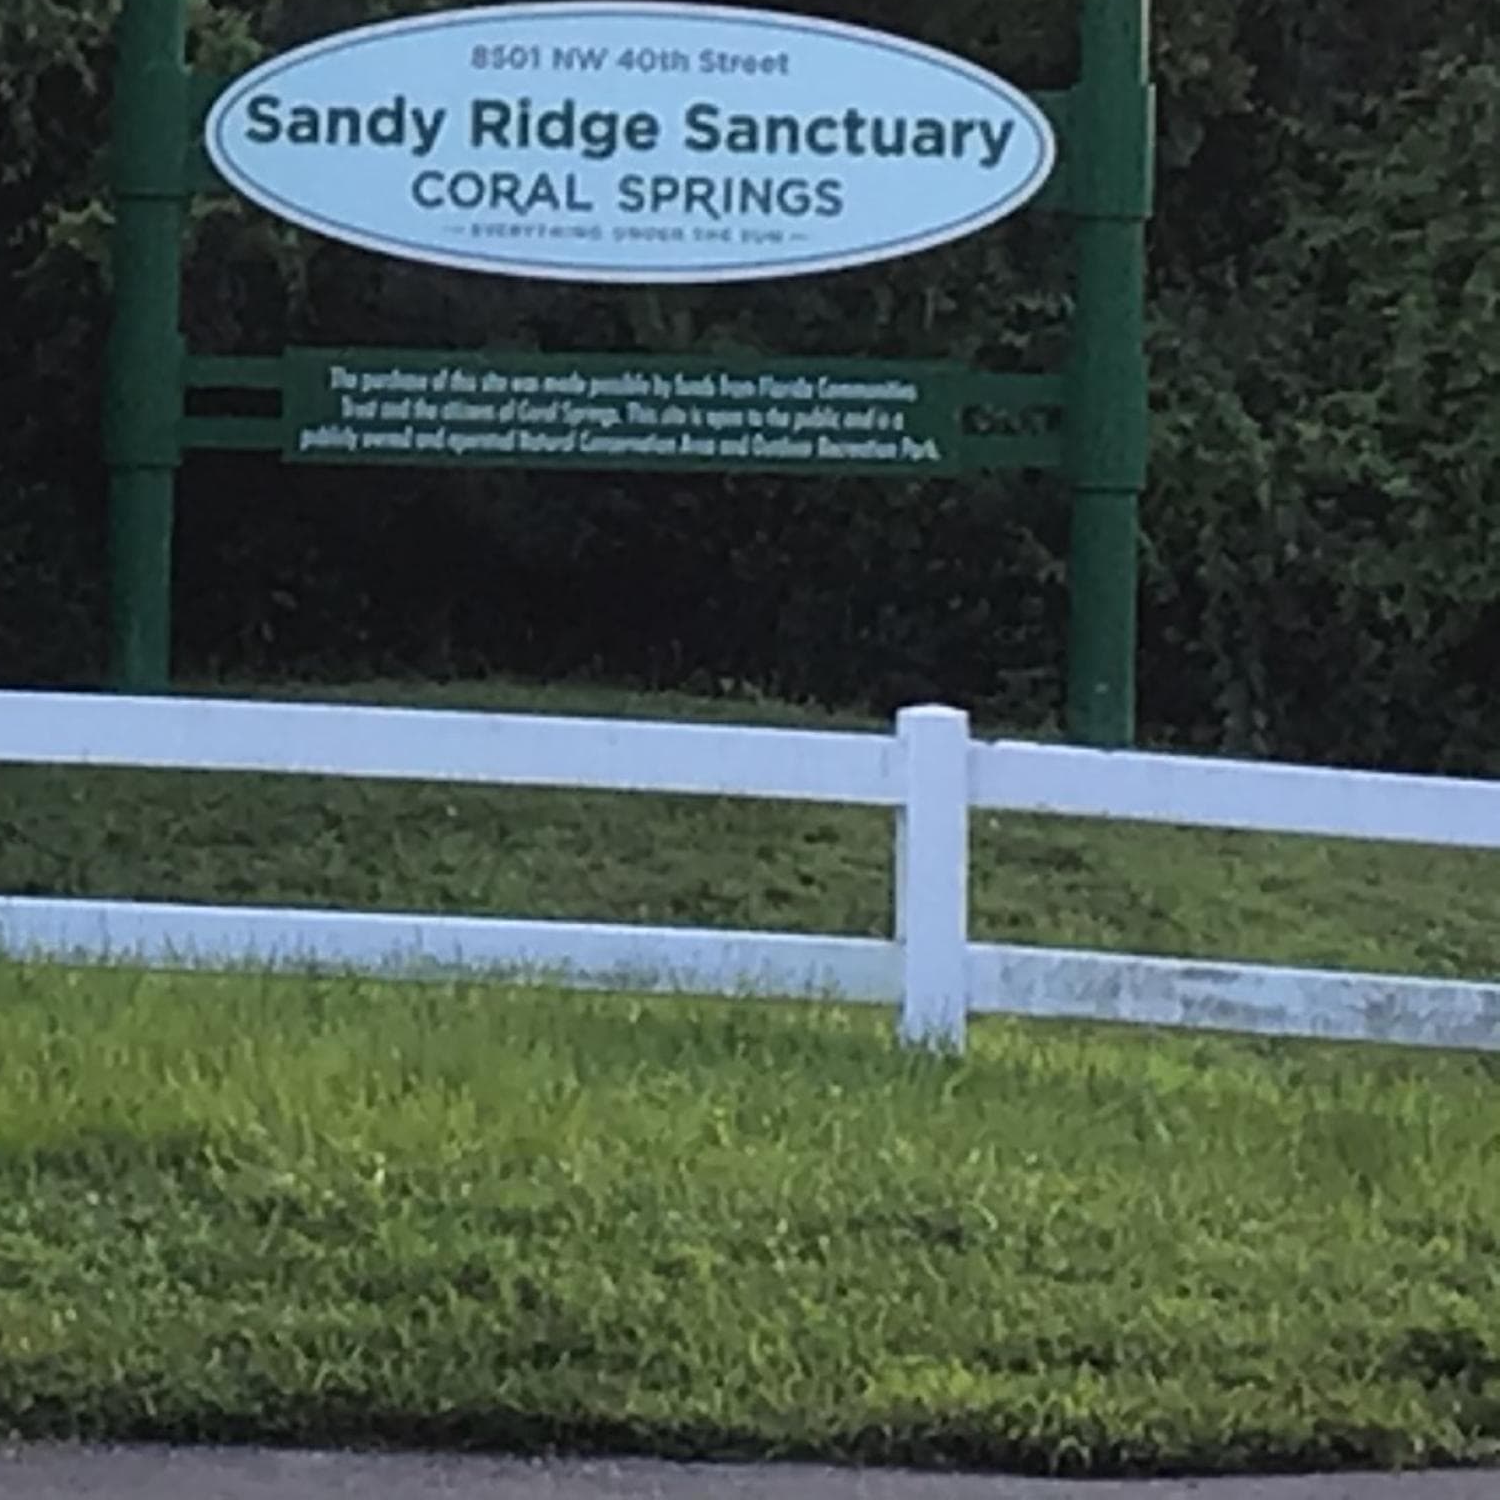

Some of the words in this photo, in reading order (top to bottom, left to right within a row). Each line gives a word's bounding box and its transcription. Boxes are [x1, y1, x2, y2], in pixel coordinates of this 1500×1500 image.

[471, 45, 540, 69] 8501
[553, 48, 608, 71] NW
[617, 49, 689, 73] 40th
[699, 50, 789, 75] Street
[244, 95, 447, 158] Sandy
[470, 99, 661, 161] Ridge
[684, 105, 1015, 170] Sanctuary
[411, 170, 594, 216] CORAL
[618, 174, 843, 220] SPRINGS
